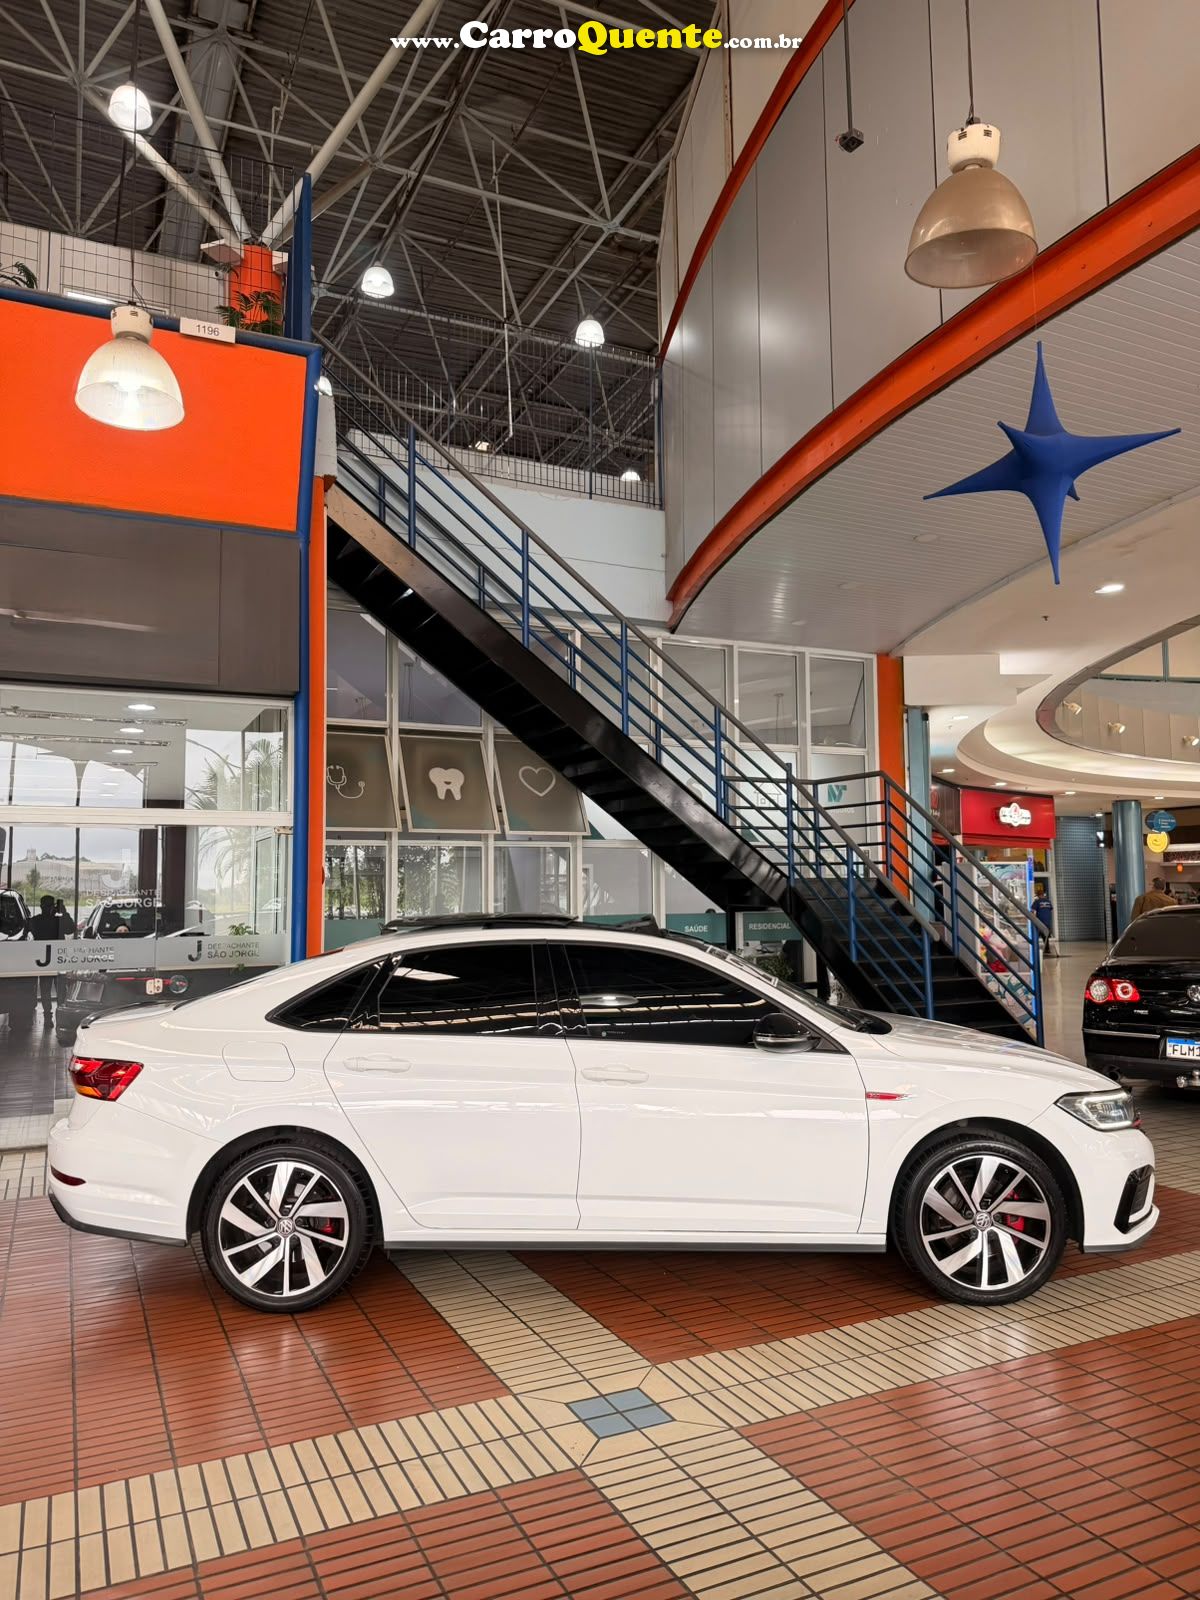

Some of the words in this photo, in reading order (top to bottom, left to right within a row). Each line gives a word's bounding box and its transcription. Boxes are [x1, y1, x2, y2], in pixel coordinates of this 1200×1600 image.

[196, 323, 221, 337] 1196
[117, 897, 163, 908] JORGE
[684, 923, 709, 933] SAÚDE
[748, 922, 792, 931] RESIDENCIAL
